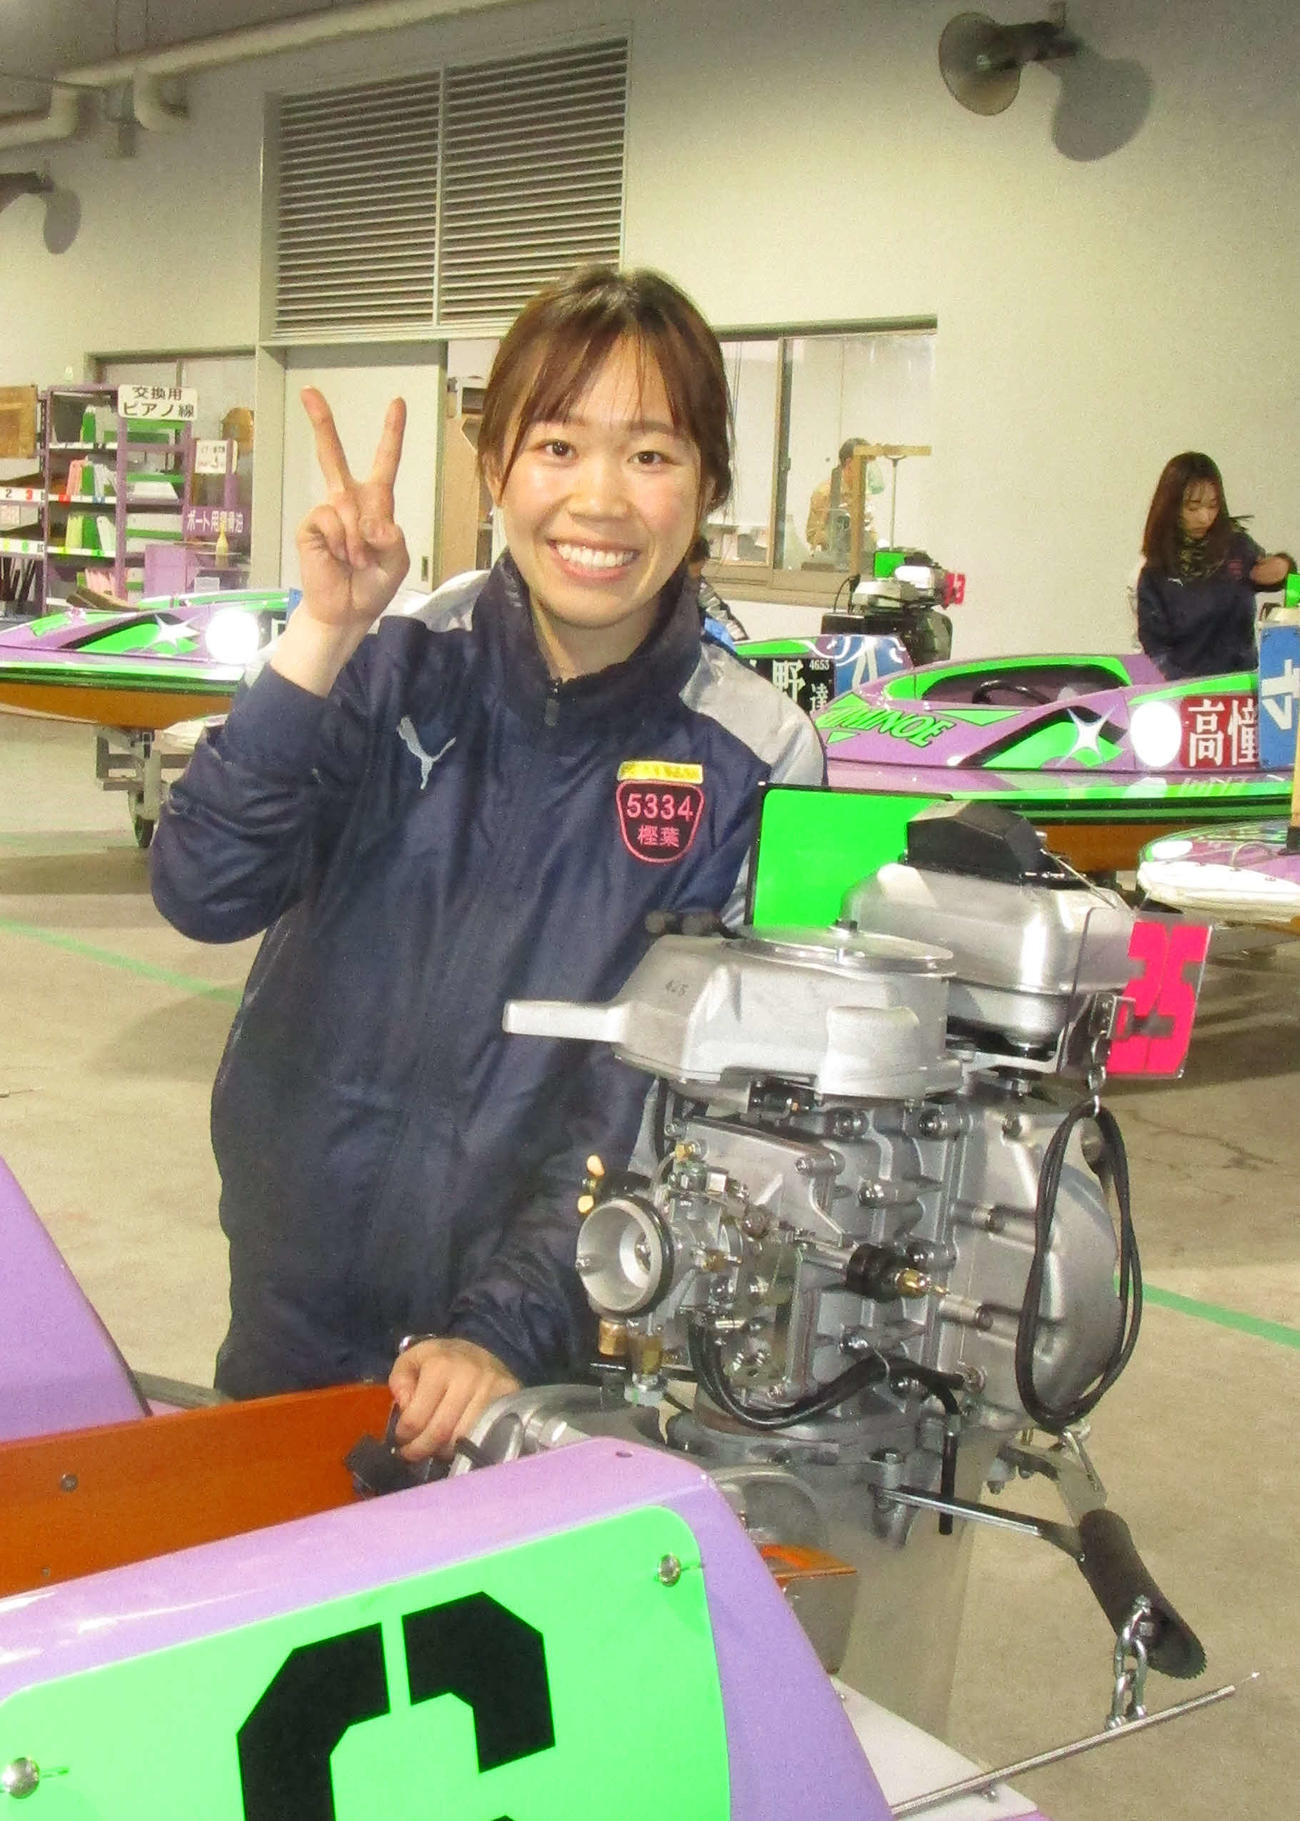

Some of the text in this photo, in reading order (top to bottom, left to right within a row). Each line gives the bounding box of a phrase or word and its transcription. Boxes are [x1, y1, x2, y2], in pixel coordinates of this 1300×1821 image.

[131, 386, 183, 401] 交換用
[123, 401, 195, 418] ピアノ線
[809, 659, 830, 671] 4653
[626, 793, 694, 822] 5334
